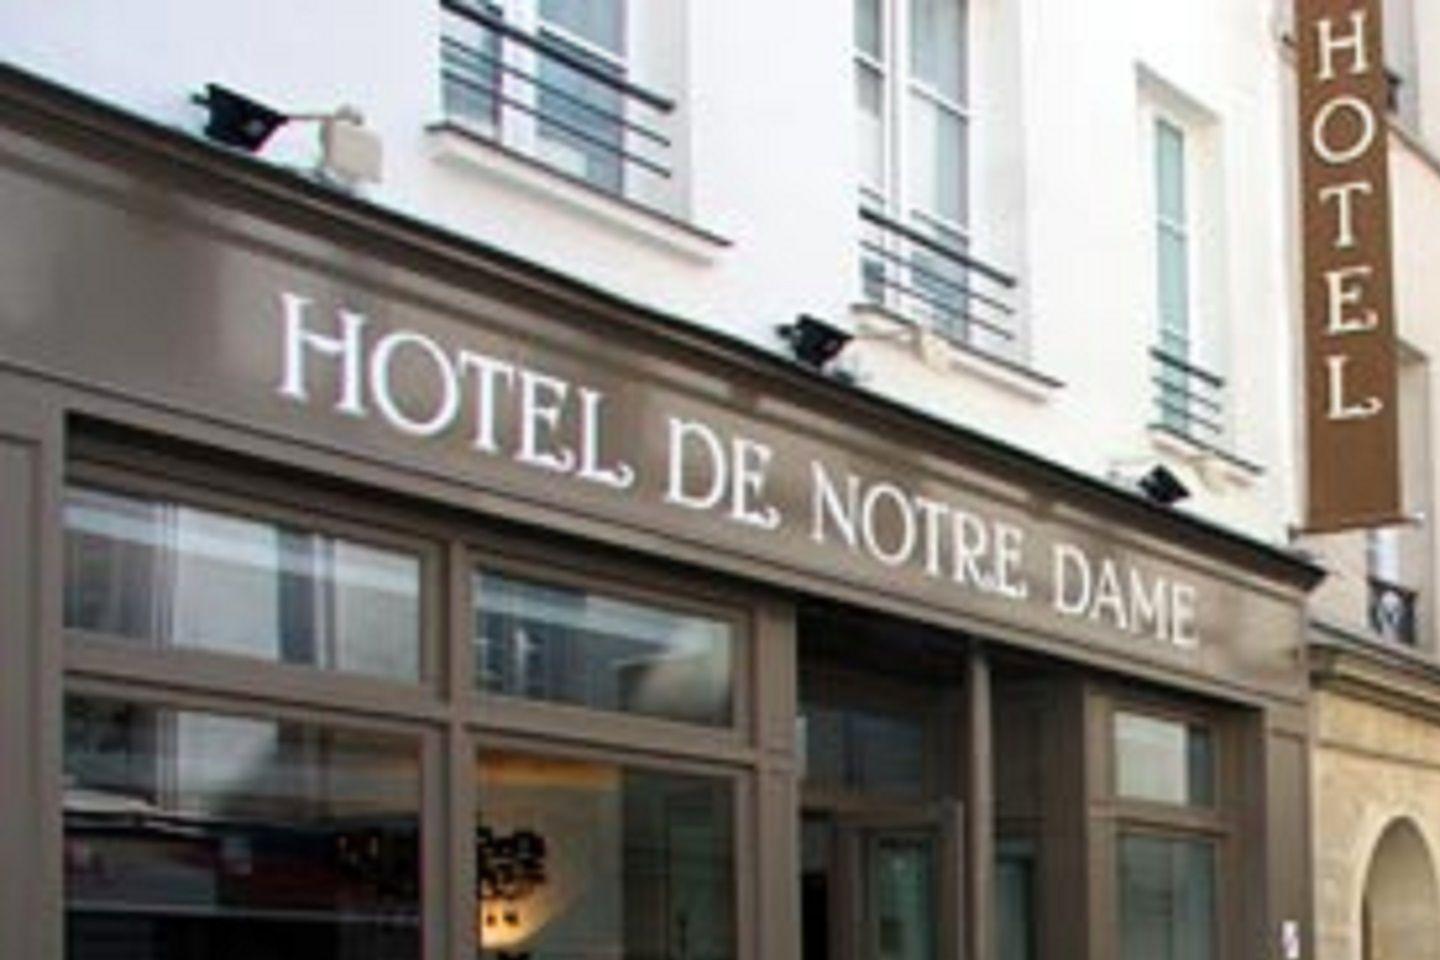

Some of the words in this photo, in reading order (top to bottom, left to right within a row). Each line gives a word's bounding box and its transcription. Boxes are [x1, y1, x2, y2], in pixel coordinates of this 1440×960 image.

[1312, 10, 1383, 421] HOTEL
[277, 292, 635, 488] HOTEL
[664, 417, 782, 530] DE
[810, 459, 1028, 600] NOTRE
[1052, 543, 1200, 647] DAME
